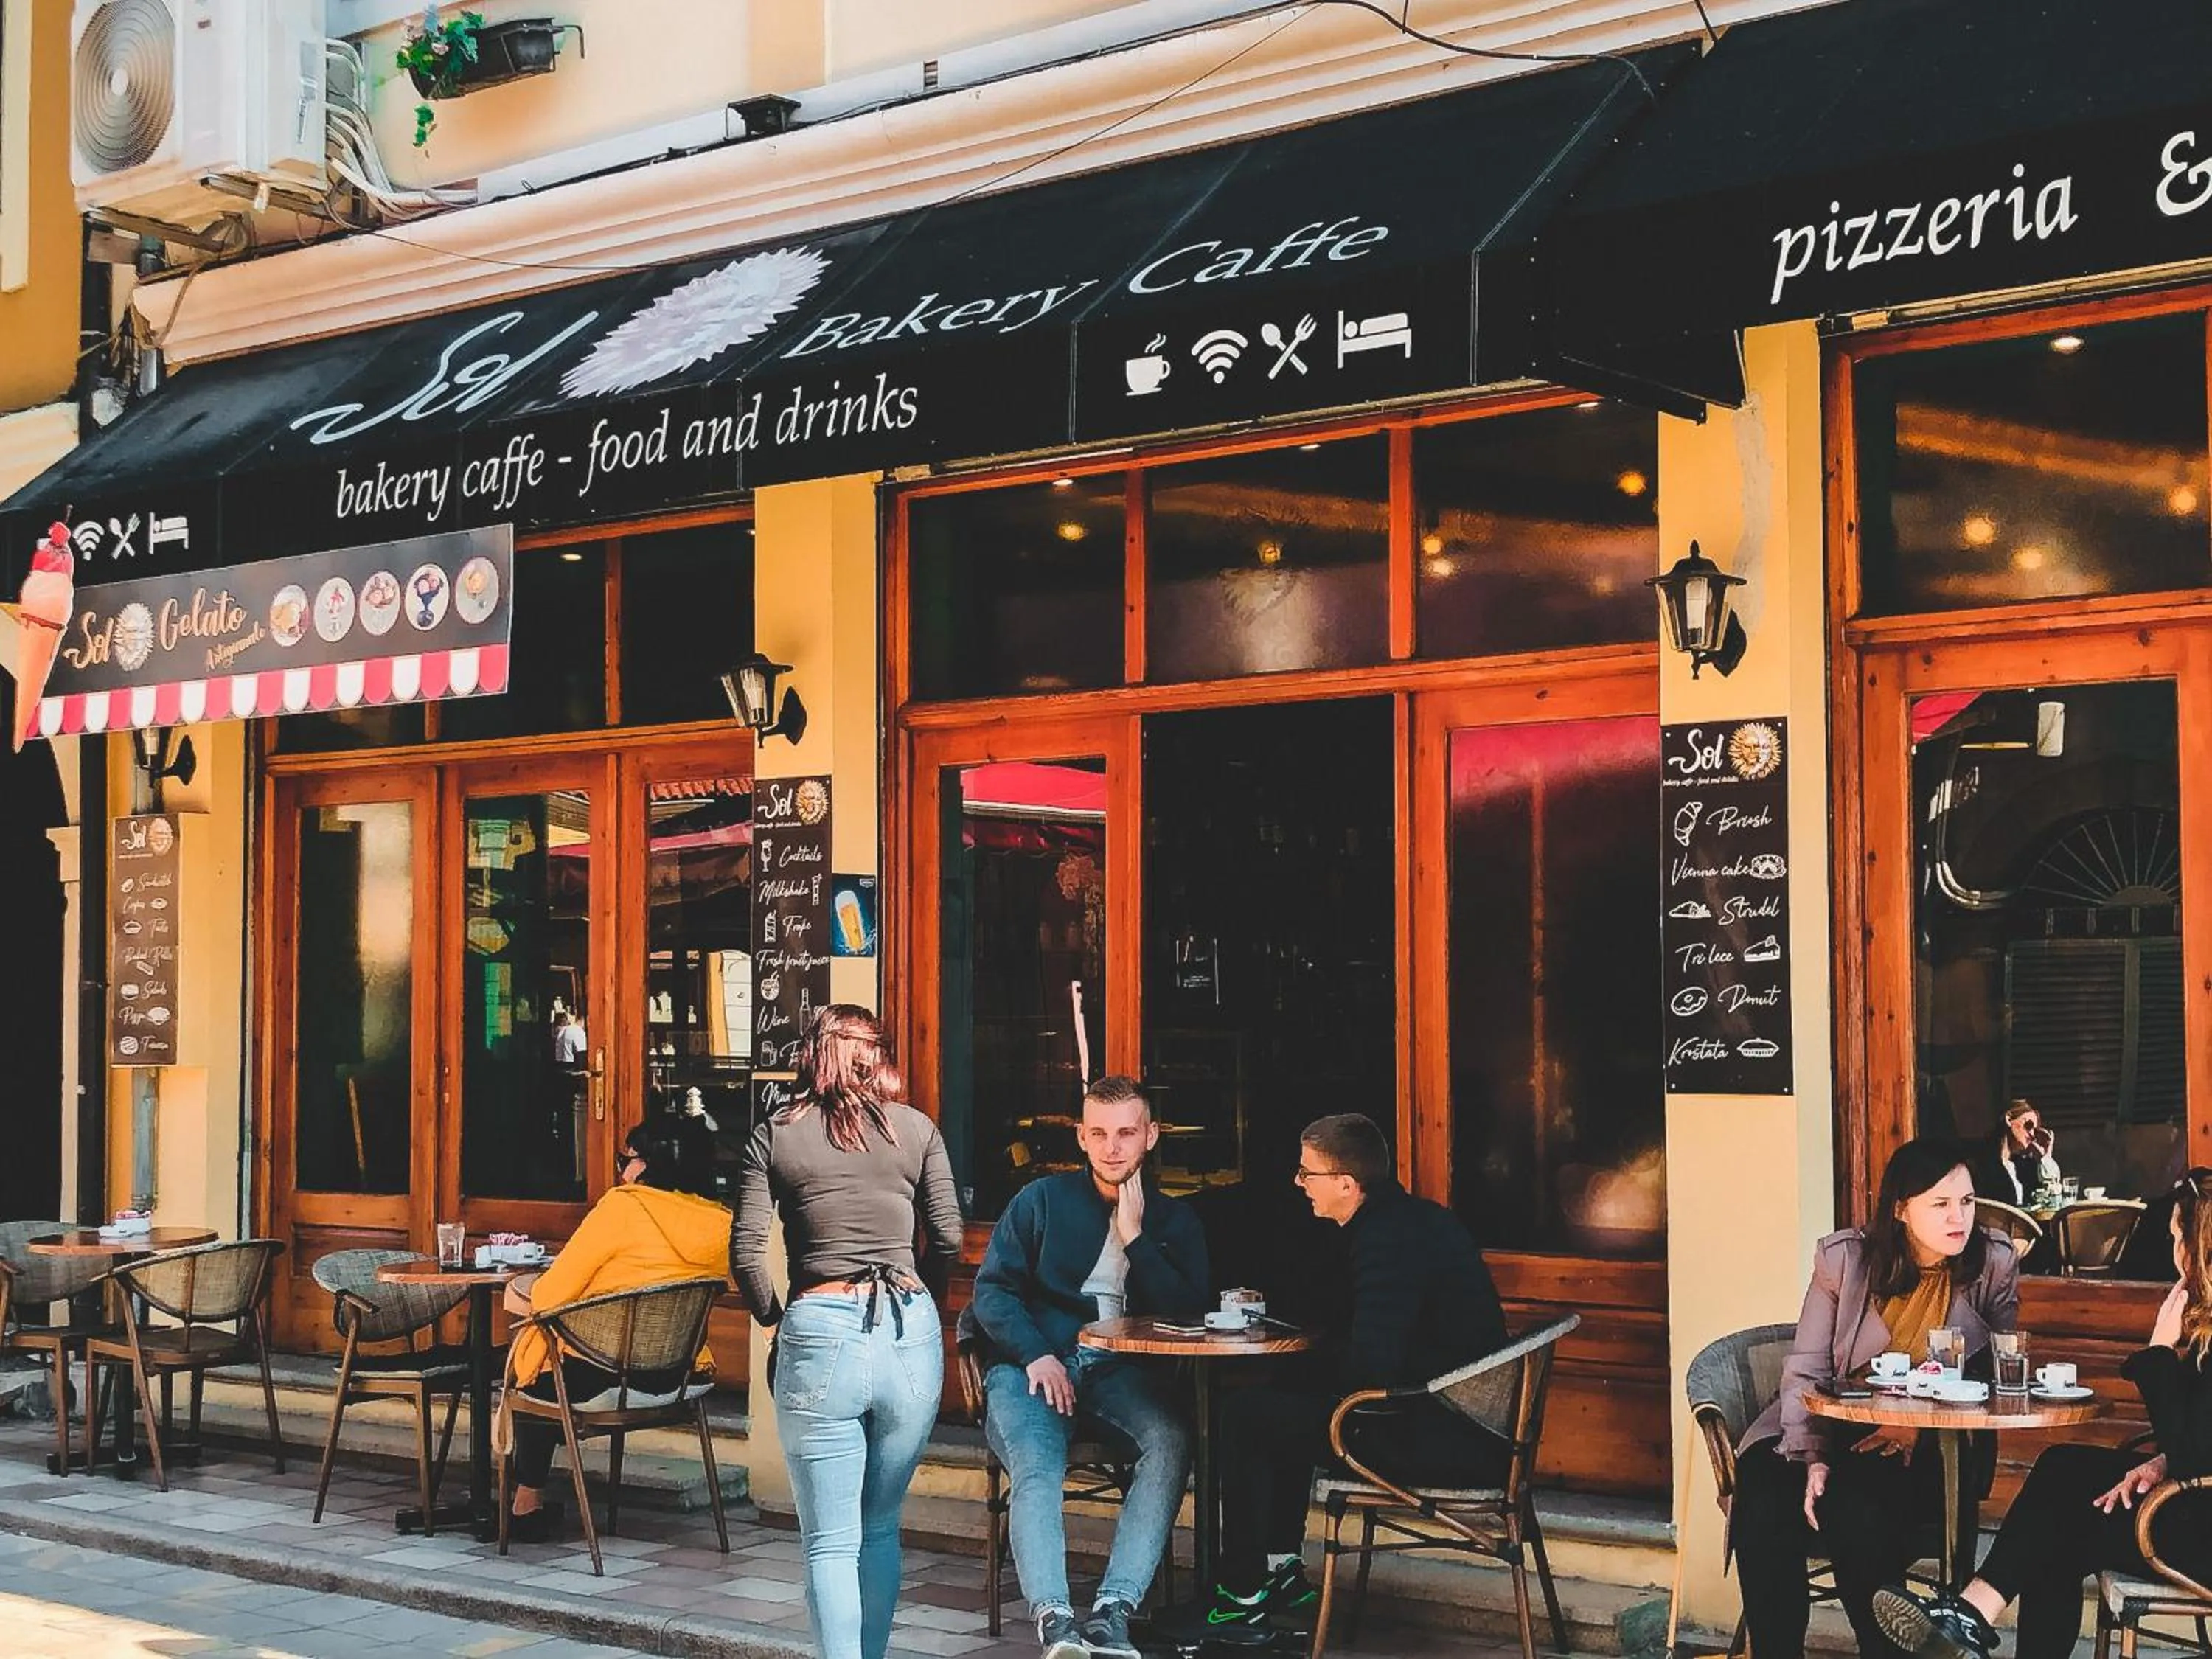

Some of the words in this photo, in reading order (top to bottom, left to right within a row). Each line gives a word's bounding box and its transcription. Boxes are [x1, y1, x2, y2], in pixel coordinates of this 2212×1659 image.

[1770, 163, 2078, 305] pizzeria
[2156, 131, 2212, 216] &
[291, 310, 598, 443] Sol
[779, 279, 1099, 358] Bakery
[1127, 215, 1388, 295] Caffe
[335, 462, 450, 521] bakery
[462, 433, 545, 509] caffe
[578, 408, 669, 497] food
[683, 396, 762, 459] and
[776, 374, 918, 442] drinks
[63, 611, 114, 669] Sol
[159, 588, 248, 651] Gelato
[1668, 728, 1724, 773] Sol
[757, 784, 793, 819] Sol
[779, 844, 823, 868] Cocktails
[1671, 852, 1719, 886] Vienna
[1721, 855, 1751, 877] cake
[759, 880, 810, 906] Milkshake
[1718, 896, 1780, 925] Strudel
[1717, 984, 1781, 1013] Donut
[757, 1005, 791, 1035] Wine
